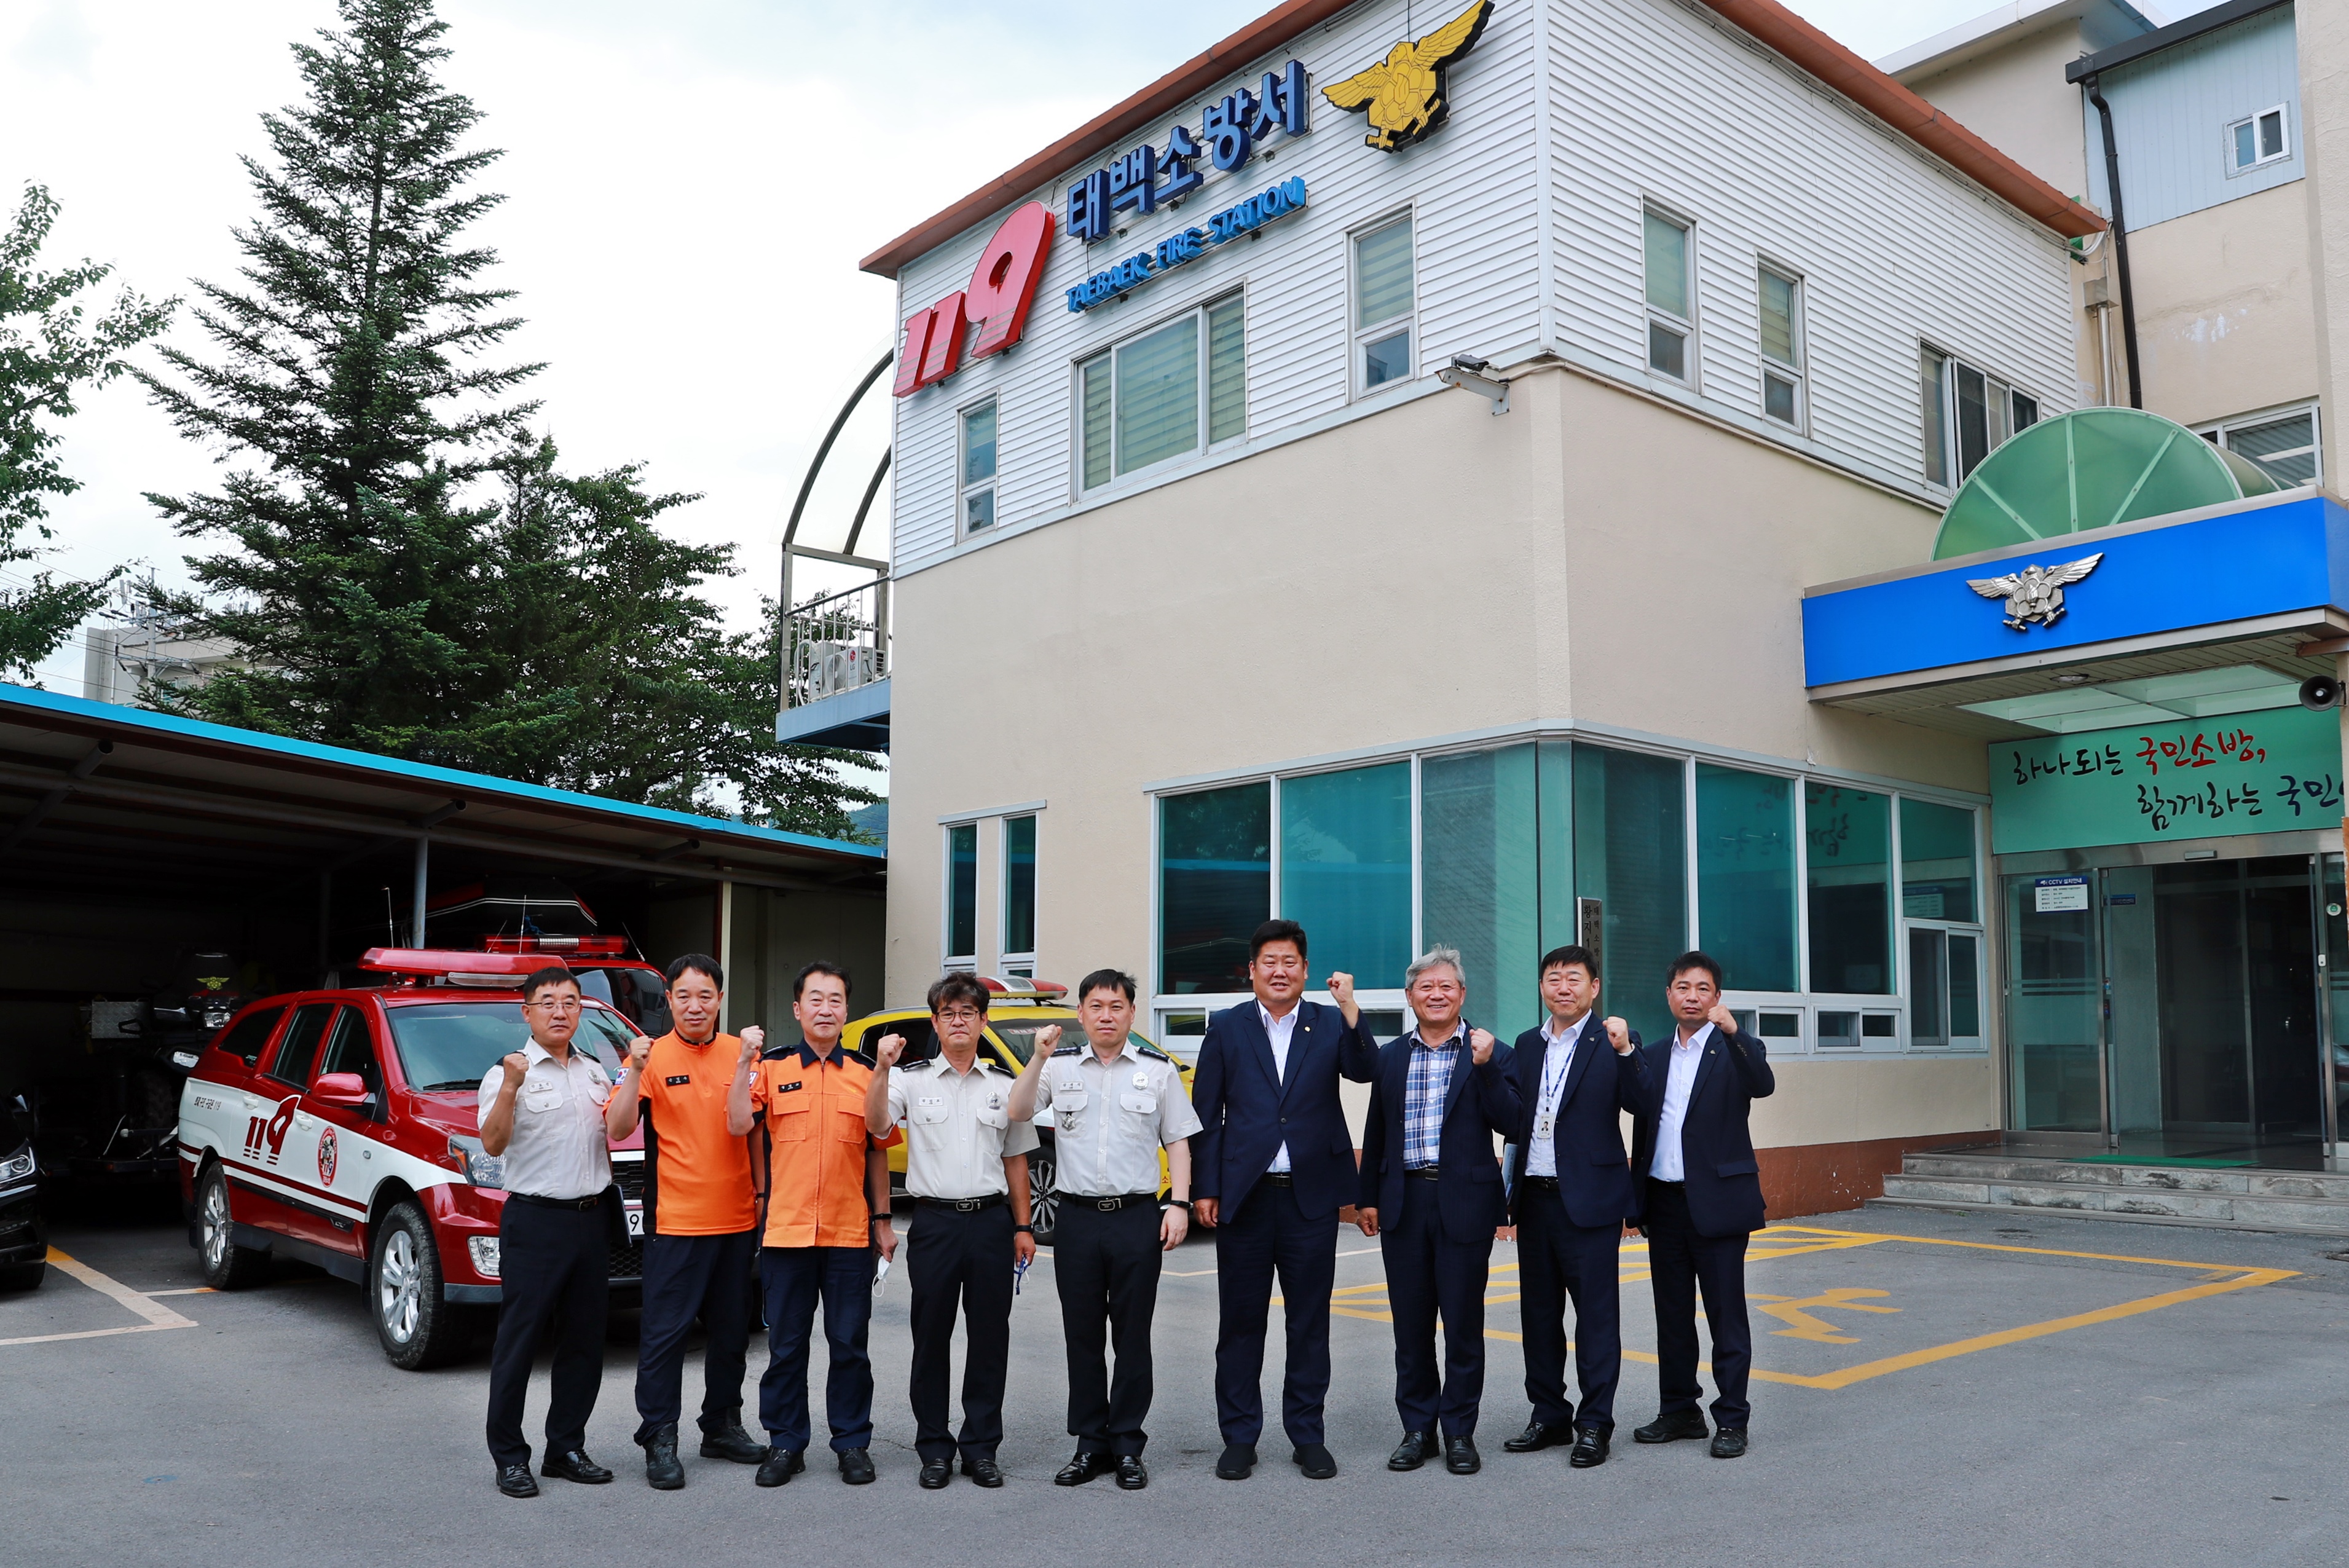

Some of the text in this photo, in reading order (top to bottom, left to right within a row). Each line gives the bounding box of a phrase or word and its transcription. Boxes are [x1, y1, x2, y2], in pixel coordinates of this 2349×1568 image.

[1067, 59, 1304, 242] 태백소방서
[1065, 175, 1305, 313] TAEBAEK FIRE STATION
[892, 200, 1056, 398] 119
[2136, 728, 2266, 776] 국민소방,
[2137, 773, 2345, 831] 함께하는 국민
[243, 1095, 301, 1165] 119
